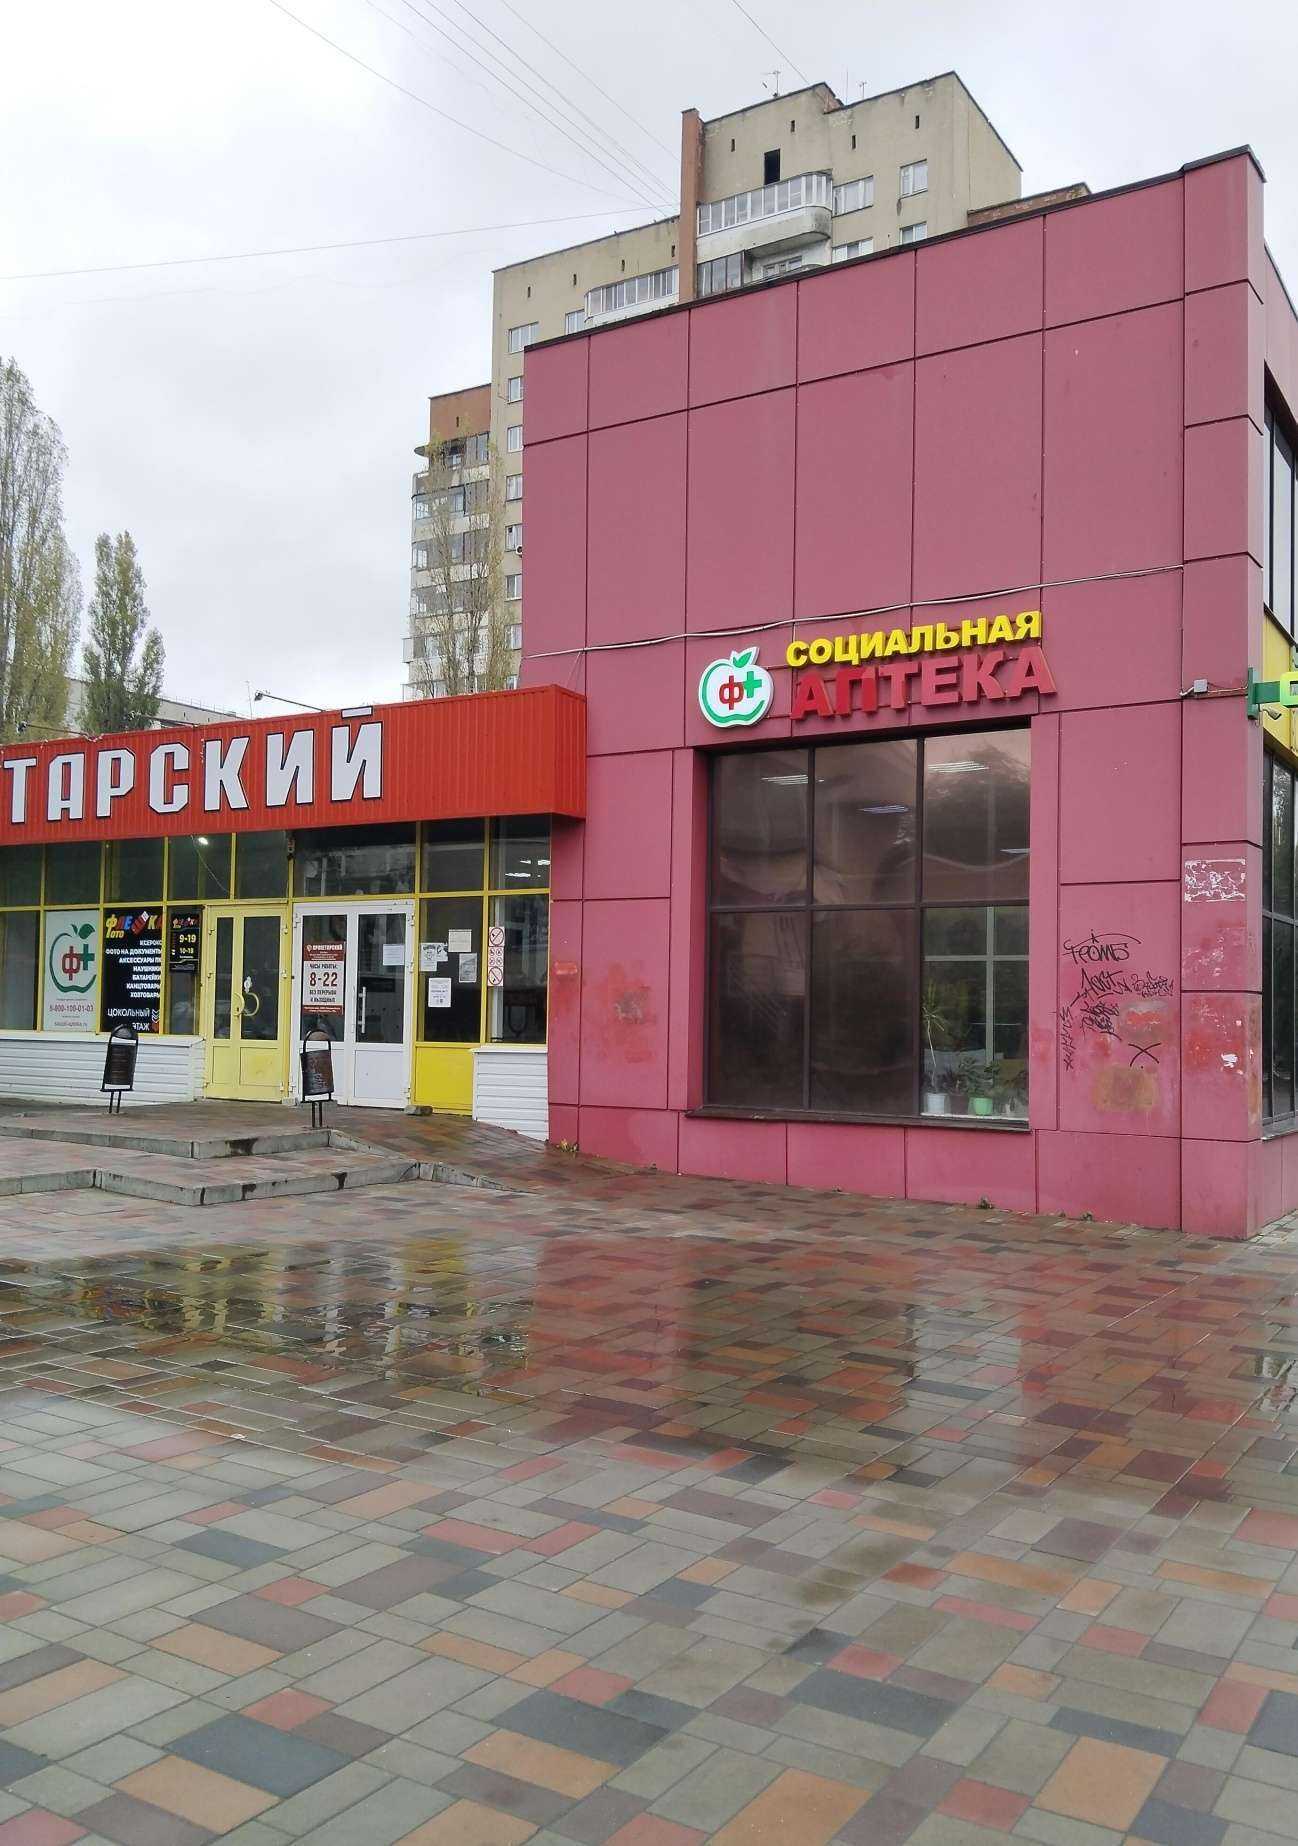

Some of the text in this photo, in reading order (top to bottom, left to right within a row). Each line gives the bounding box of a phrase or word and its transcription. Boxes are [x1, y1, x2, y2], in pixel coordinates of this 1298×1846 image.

[786, 611, 1043, 667] СОЦИАЛЬНАЯ
[790, 646, 1059, 722] АПТЕКА
[3, 705, 384, 826] ТАРСКИЙ
[309, 971, 338, 987] 8-22
[107, 1007, 150, 1017] ЦОКОЛЬНЫЙ
[132, 1021, 150, 1031] ЭТАЖ
